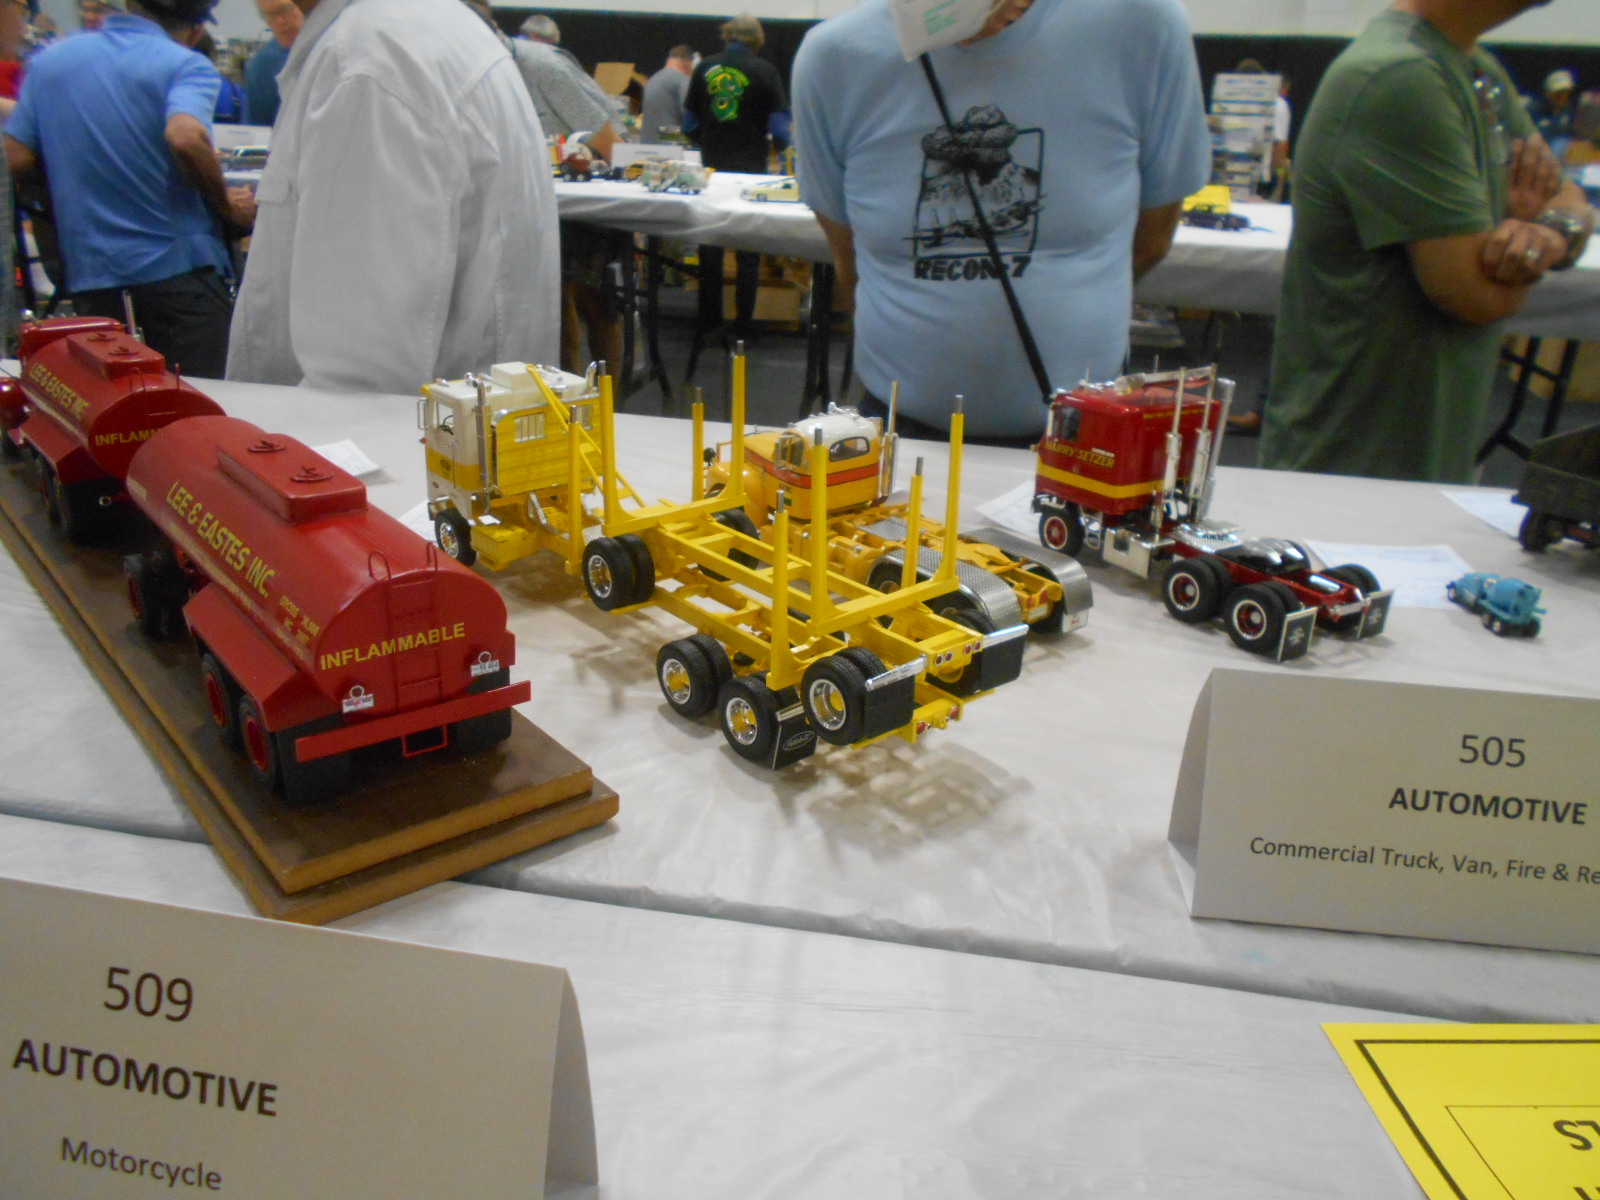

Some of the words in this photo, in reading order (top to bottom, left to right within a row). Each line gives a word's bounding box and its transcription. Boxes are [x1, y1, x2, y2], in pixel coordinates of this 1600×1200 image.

[166, 481, 194, 517] LEE
[187, 502, 203, 525] &
[197, 512, 251, 571] EASTES
[320, 622, 466, 671] INFLAMMABLE
[1459, 734, 1527, 768] 505
[1389, 787, 1588, 825] AUTOMOTIVE
[1250, 836, 1375, 865] Commercial
[1382, 847, 1444, 873] Truck,
[1453, 854, 1498, 879] Van,
[1506, 859, 1546, 880] Fire
[1553, 863, 1569, 881] &
[103, 966, 194, 1023] 509
[12, 1038, 278, 1117] AUTOMOTIVE
[60, 1136, 222, 1192] Motorcycle
